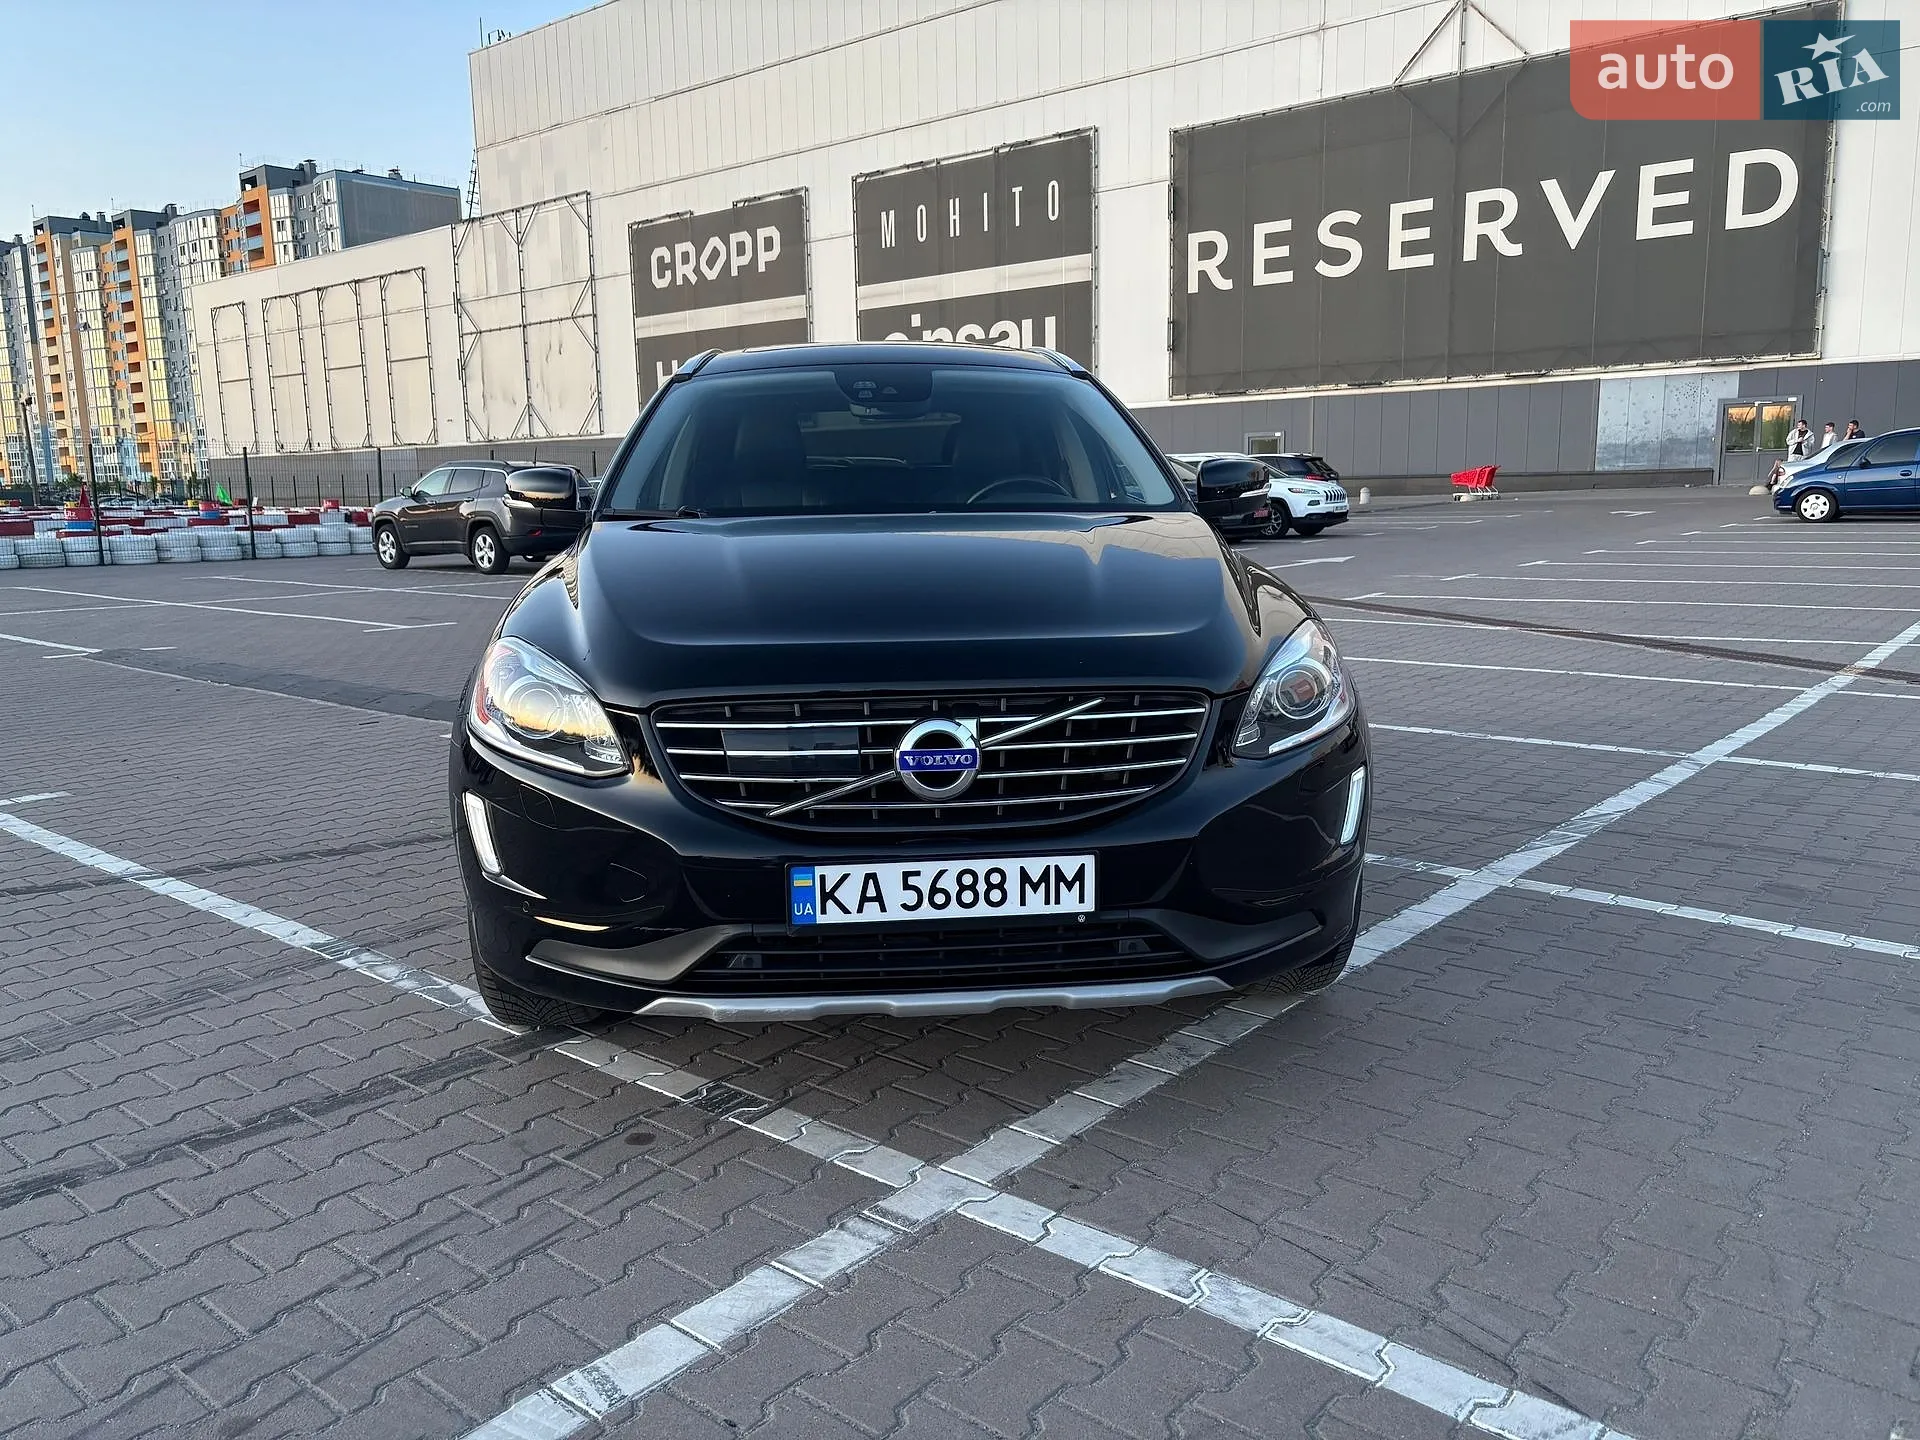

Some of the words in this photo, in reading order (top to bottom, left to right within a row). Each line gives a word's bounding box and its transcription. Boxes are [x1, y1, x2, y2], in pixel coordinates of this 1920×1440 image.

[880, 180, 1061, 249] MOHITO
[1187, 148, 1800, 294] RESERVED
[650, 226, 781, 288] CROPP
[903, 754, 973, 767] VOLVO
[794, 903, 814, 916] UA
[818, 872, 888, 915] KA
[899, 867, 1008, 911] 5688
[1019, 862, 1086, 907] MM
